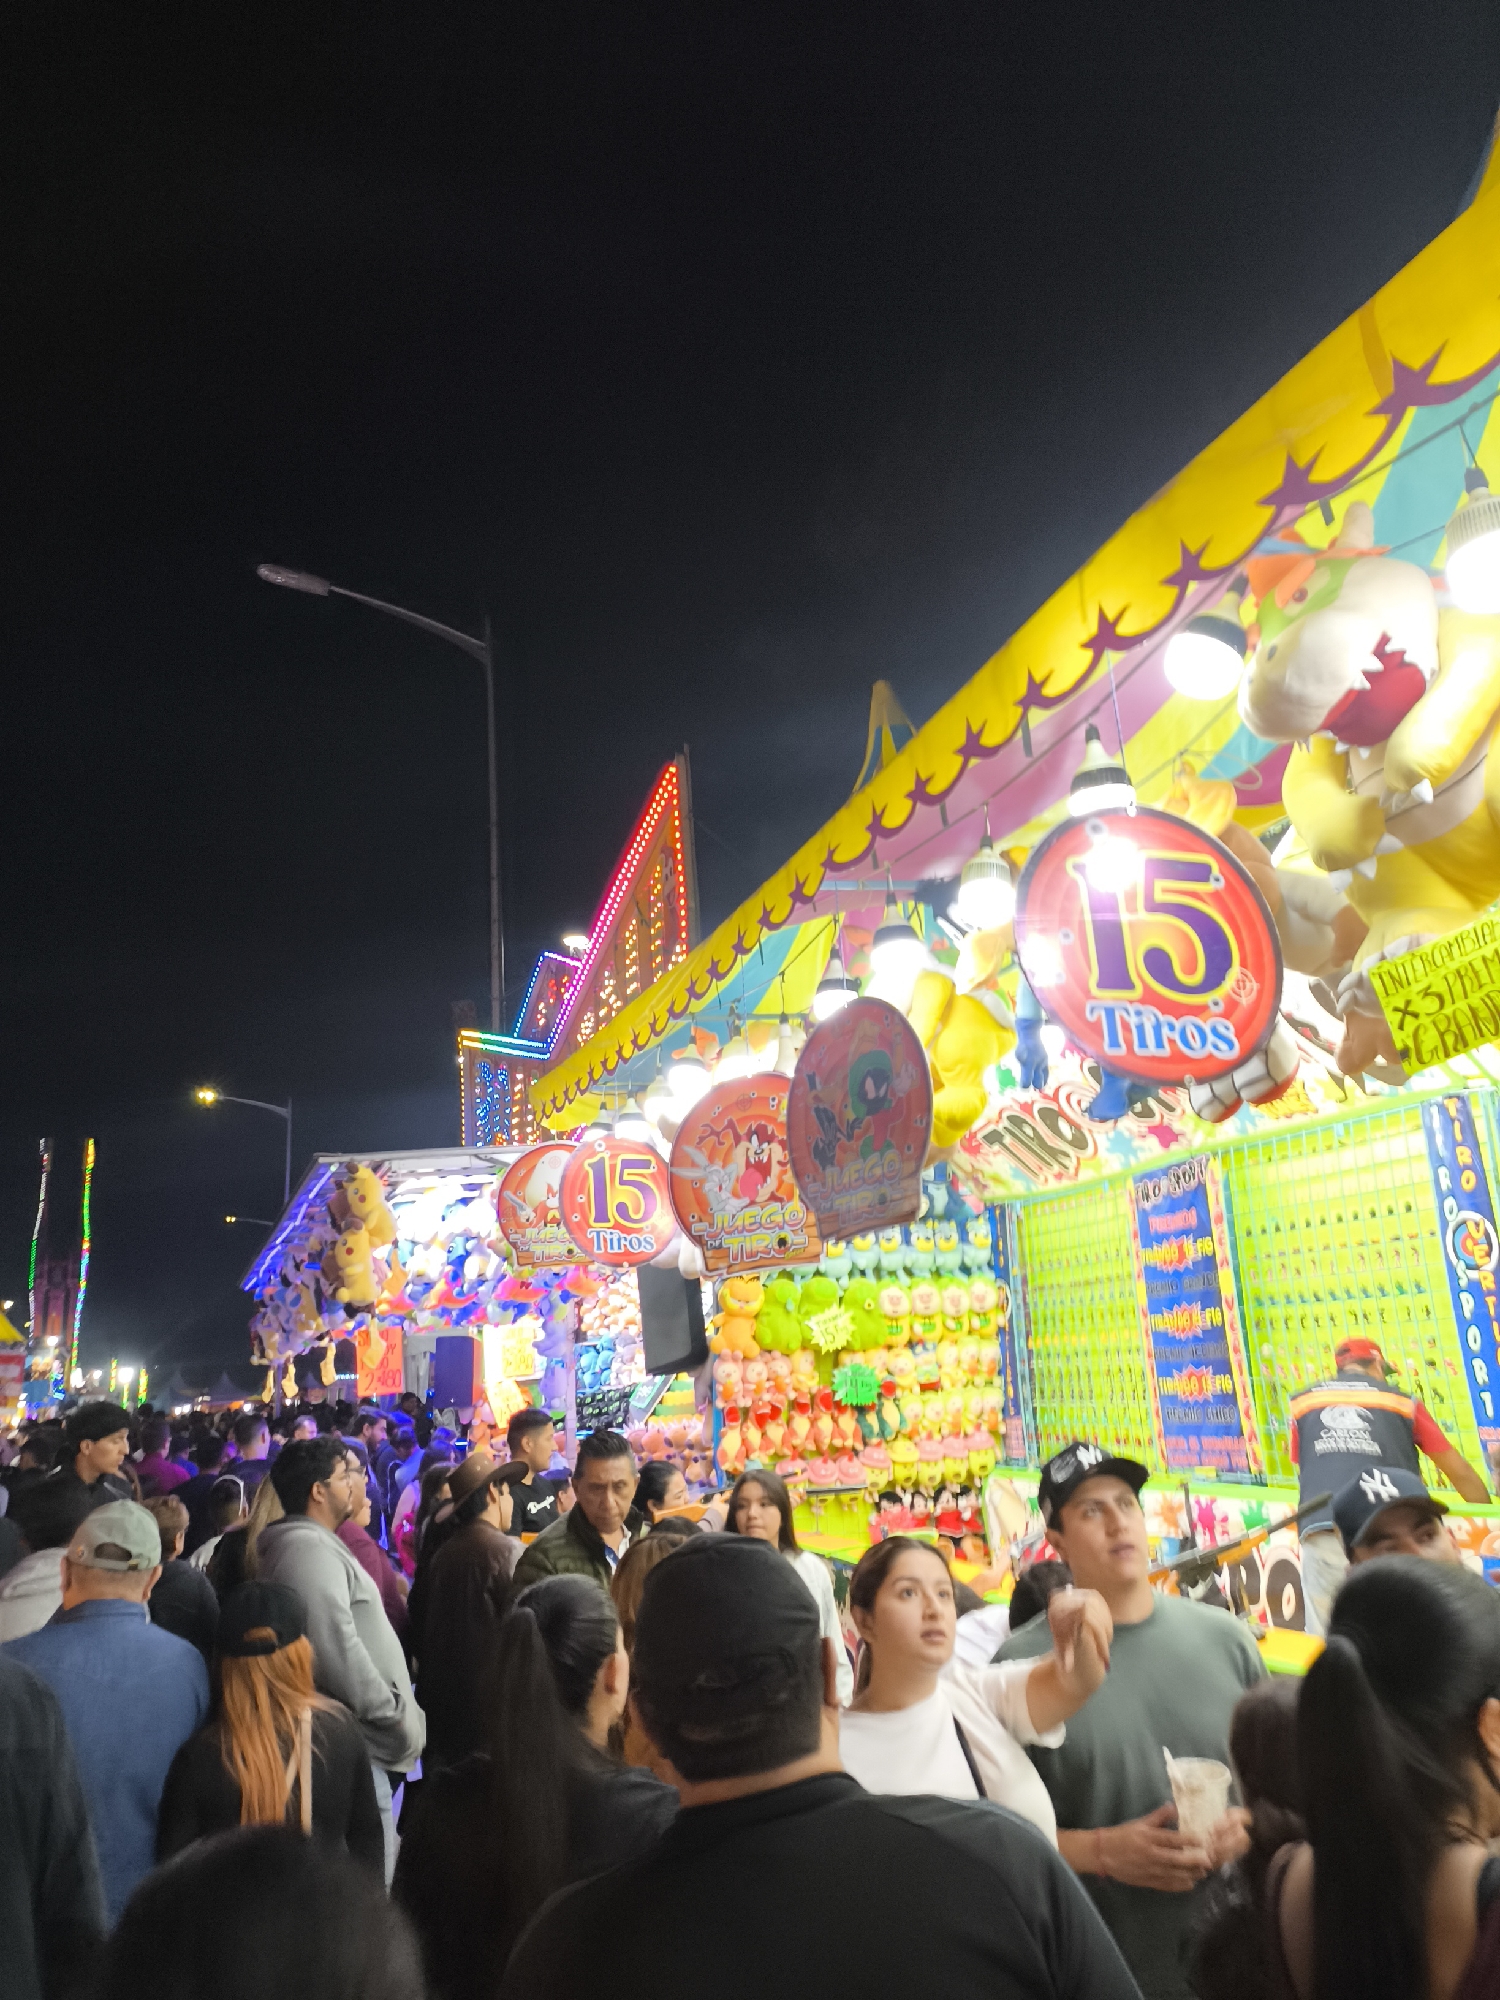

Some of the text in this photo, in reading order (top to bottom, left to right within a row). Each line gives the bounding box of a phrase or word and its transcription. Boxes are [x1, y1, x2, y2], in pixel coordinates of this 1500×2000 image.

[1065, 849, 1240, 1006] 15
[1086, 1000, 1240, 1059] Tiros
[584, 1152, 661, 1228] 15
[520, 1227, 574, 1245] JUEG
[587, 1229, 656, 1254] Tiros
[723, 1231, 793, 1264] TIRO
[1360, 1468, 1400, 1504] NY
